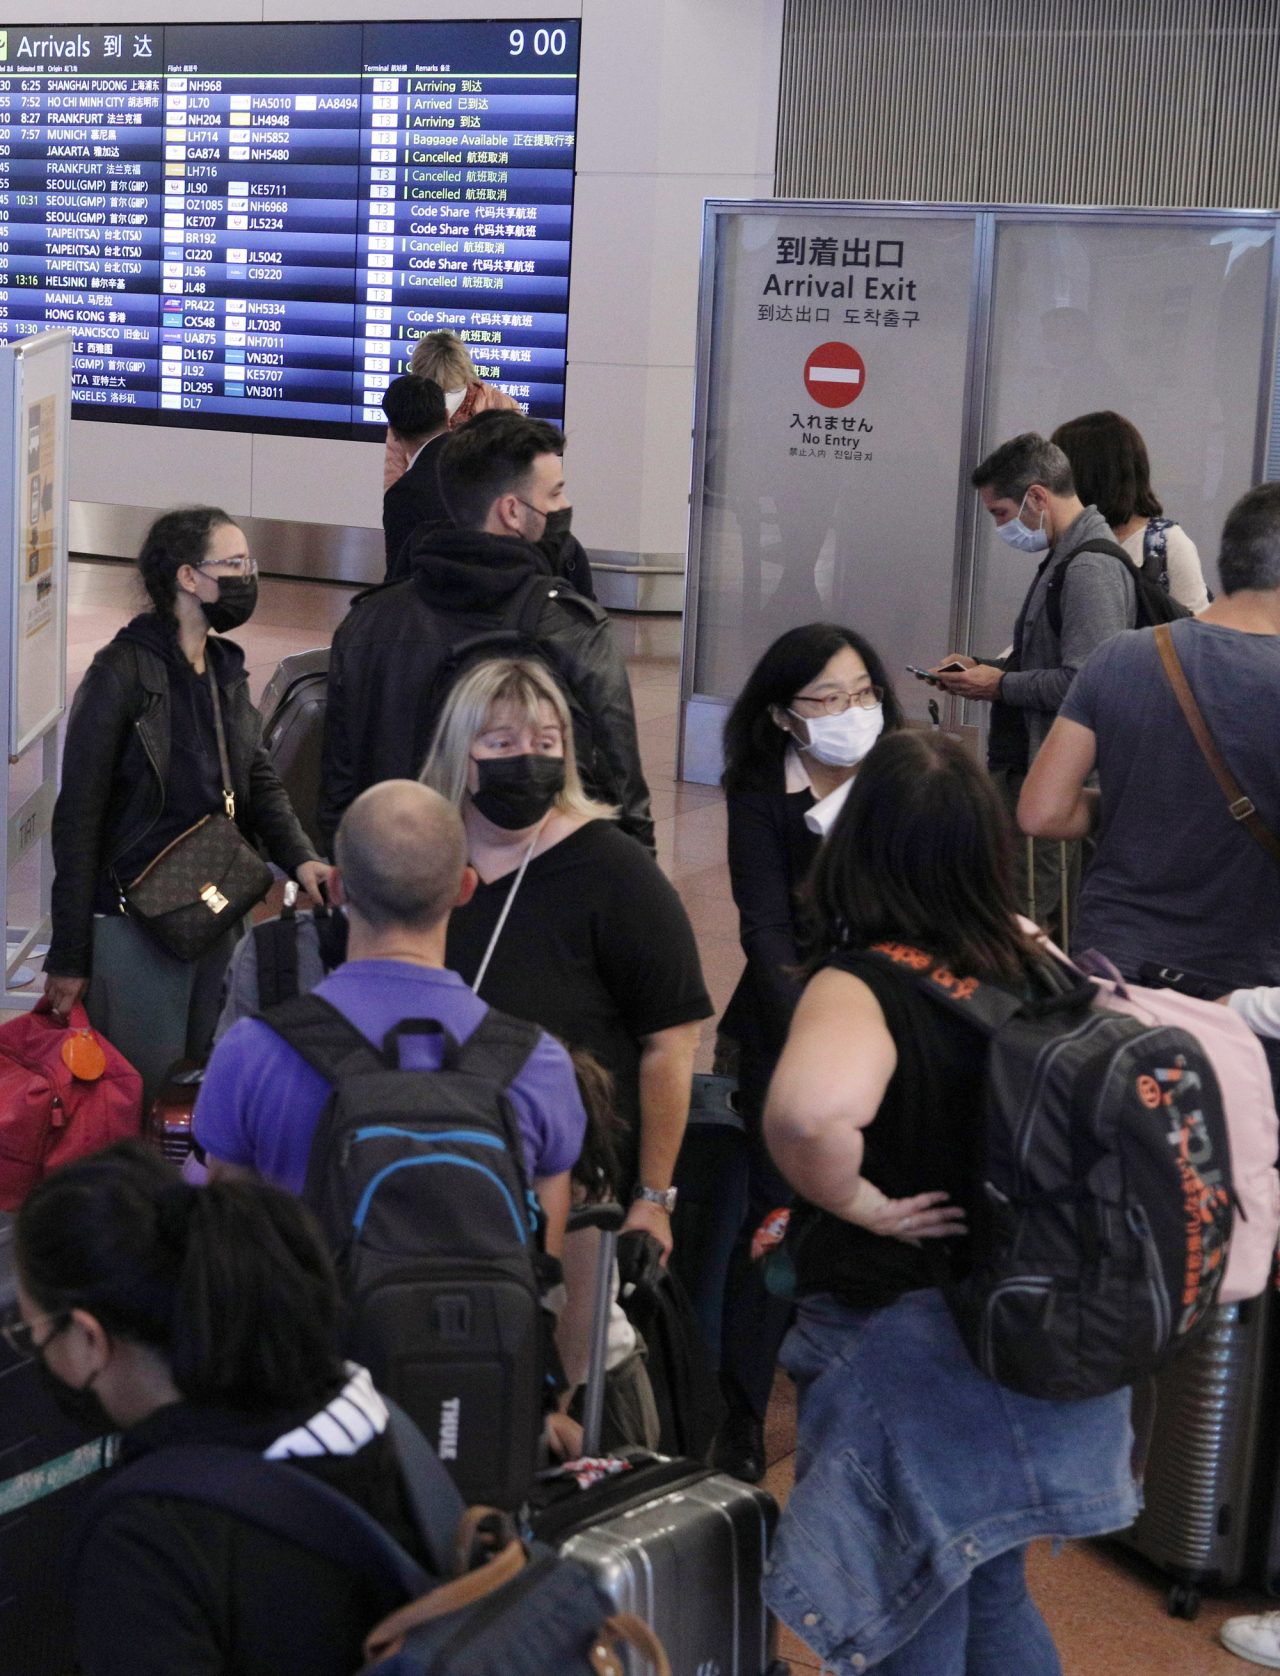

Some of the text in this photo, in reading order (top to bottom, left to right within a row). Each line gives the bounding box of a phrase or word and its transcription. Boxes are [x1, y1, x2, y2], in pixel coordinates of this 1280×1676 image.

[17, 34, 91, 58] Arrivals
[21, 80, 41, 91] 6:25
[47, 79, 160, 91] SHANGHAI PUDONG 上海浦东
[189, 80, 222, 92] NH968
[414, 79, 482, 93] Arriving 到达
[21, 96, 40, 107] 7:52
[47, 96, 61, 107] HO
[62, 97, 76, 107] CHI
[80, 97, 103, 107] MINH
[105, 97, 125, 107] CITY
[188, 97, 358, 109] JL70 HA5010 AA8494
[414, 98, 488, 110] Arrived 已到达
[20, 112, 41, 124] 8:27
[47, 112, 142, 125] FRANKFURT 法兰克福
[188, 114, 289, 126] NH204 LH4948
[413, 115, 481, 128] Arriving 到达
[21, 129, 40, 140] 7:57
[48, 129, 87, 140] MUNICH
[188, 131, 289, 143] LH714 NH5852
[413, 134, 458, 145] Baggage
[460, 134, 507, 146] Available
[46, 145, 90, 157] JAKARTA
[187, 147, 289, 161] GA874 NH5480
[412, 151, 508, 164] Cancelled 航班取消
[46, 162, 140, 175] FRANKFURT 法兰克福
[187, 166, 218, 177] LH716
[46, 179, 106, 192] SEOUL(GMP)
[186, 182, 286, 196] JL90 KE5711
[16, 195, 38, 205] 10:31
[46, 195, 106, 208] SEOUL(GMP)
[186, 199, 288, 213] OZ1085 NH6968
[45, 211, 106, 224] SEOUL(GMP)
[411, 205, 537, 219] Code Share 代码共享航班
[186, 216, 283, 230] KE707 JL5234
[46, 227, 100, 240] TAIPEI(TSA)
[186, 233, 216, 244] BR192
[45, 243, 100, 257] TAIPEI(TSA)
[185, 249, 282, 263] CI220 JL5042
[776, 236, 905, 268] 到着出口
[45, 259, 100, 273] TAIPEI(TSA)
[185, 266, 282, 280] JL96 CI9220
[15, 274, 38, 286] 13:16
[45, 275, 87, 288] HELSINKI
[184, 282, 206, 293] JL48
[763, 273, 917, 301] Arrival Exit
[46, 293, 113, 306] MANILA 马尼拉
[185, 299, 285, 315] PR422 NH5334
[45, 308, 126, 323] HONG KONG 香港
[757, 304, 920, 328] 到达出口 도착출구
[15, 323, 38, 334] 13:30
[184, 316, 281, 332] CX548 JL7030
[67, 326, 120, 339] RANCISCO
[123, 329, 150, 340] 旧金山
[184, 332, 283, 348] UA875 NH7011
[183, 348, 284, 367] DL167 VN3021
[183, 365, 283, 381] JL92 KE5707
[92, 375, 126, 390] 亚特兰大
[183, 382, 283, 398] DL295 VN3011
[72, 390, 136, 404] NGELES 洛杉矶
[183, 398, 202, 409] DL7
[789, 413, 874, 433] 入れません
[802, 433, 860, 449] No Entry
[834, 450, 873, 462] 진입금지
[440, 1396, 461, 1459] THULE
